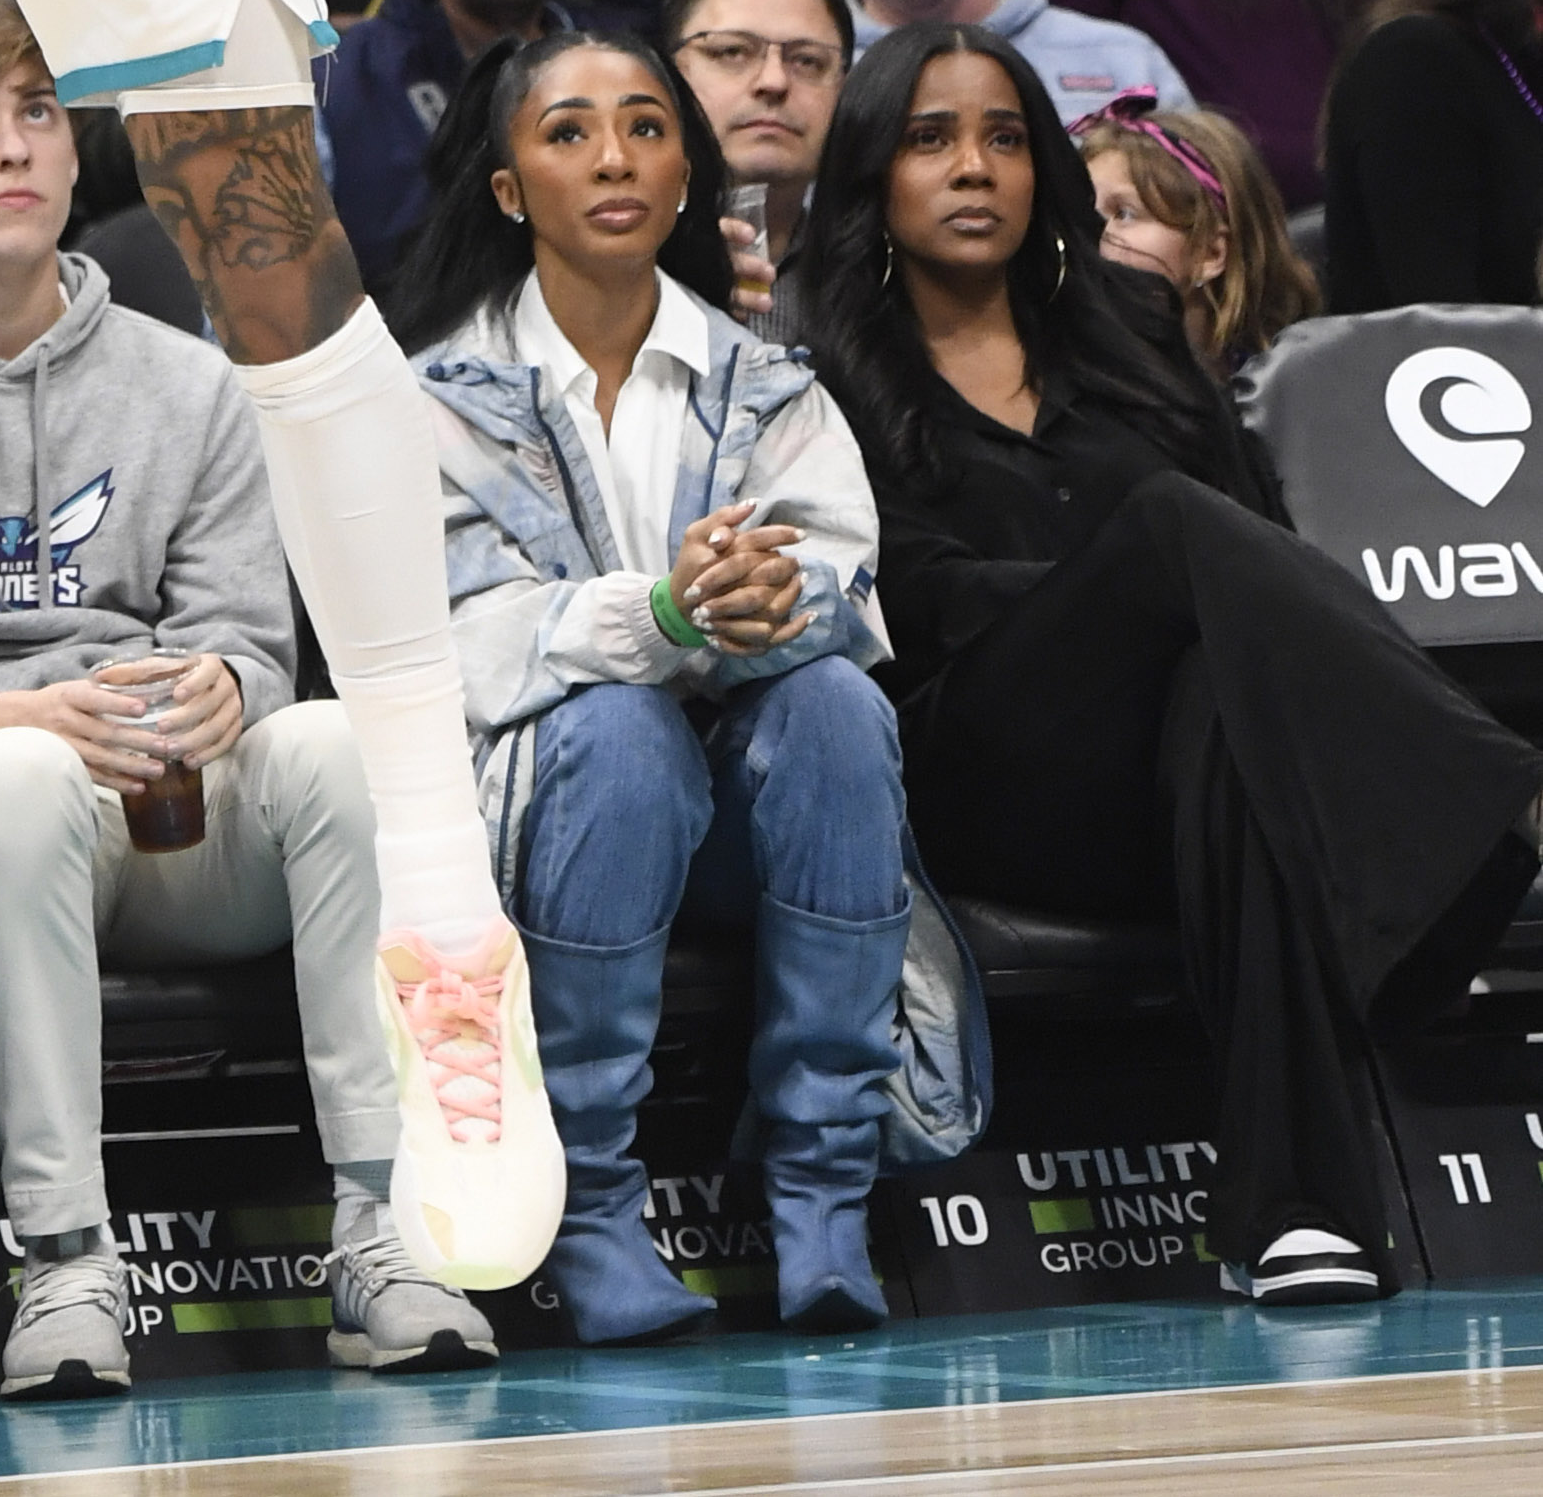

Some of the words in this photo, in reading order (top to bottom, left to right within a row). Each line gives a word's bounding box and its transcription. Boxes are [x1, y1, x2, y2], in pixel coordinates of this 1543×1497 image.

[1438, 1153, 1493, 1205] 11
[919, 1194, 989, 1247] 10
[1040, 1235, 1184, 1273] GROUP
